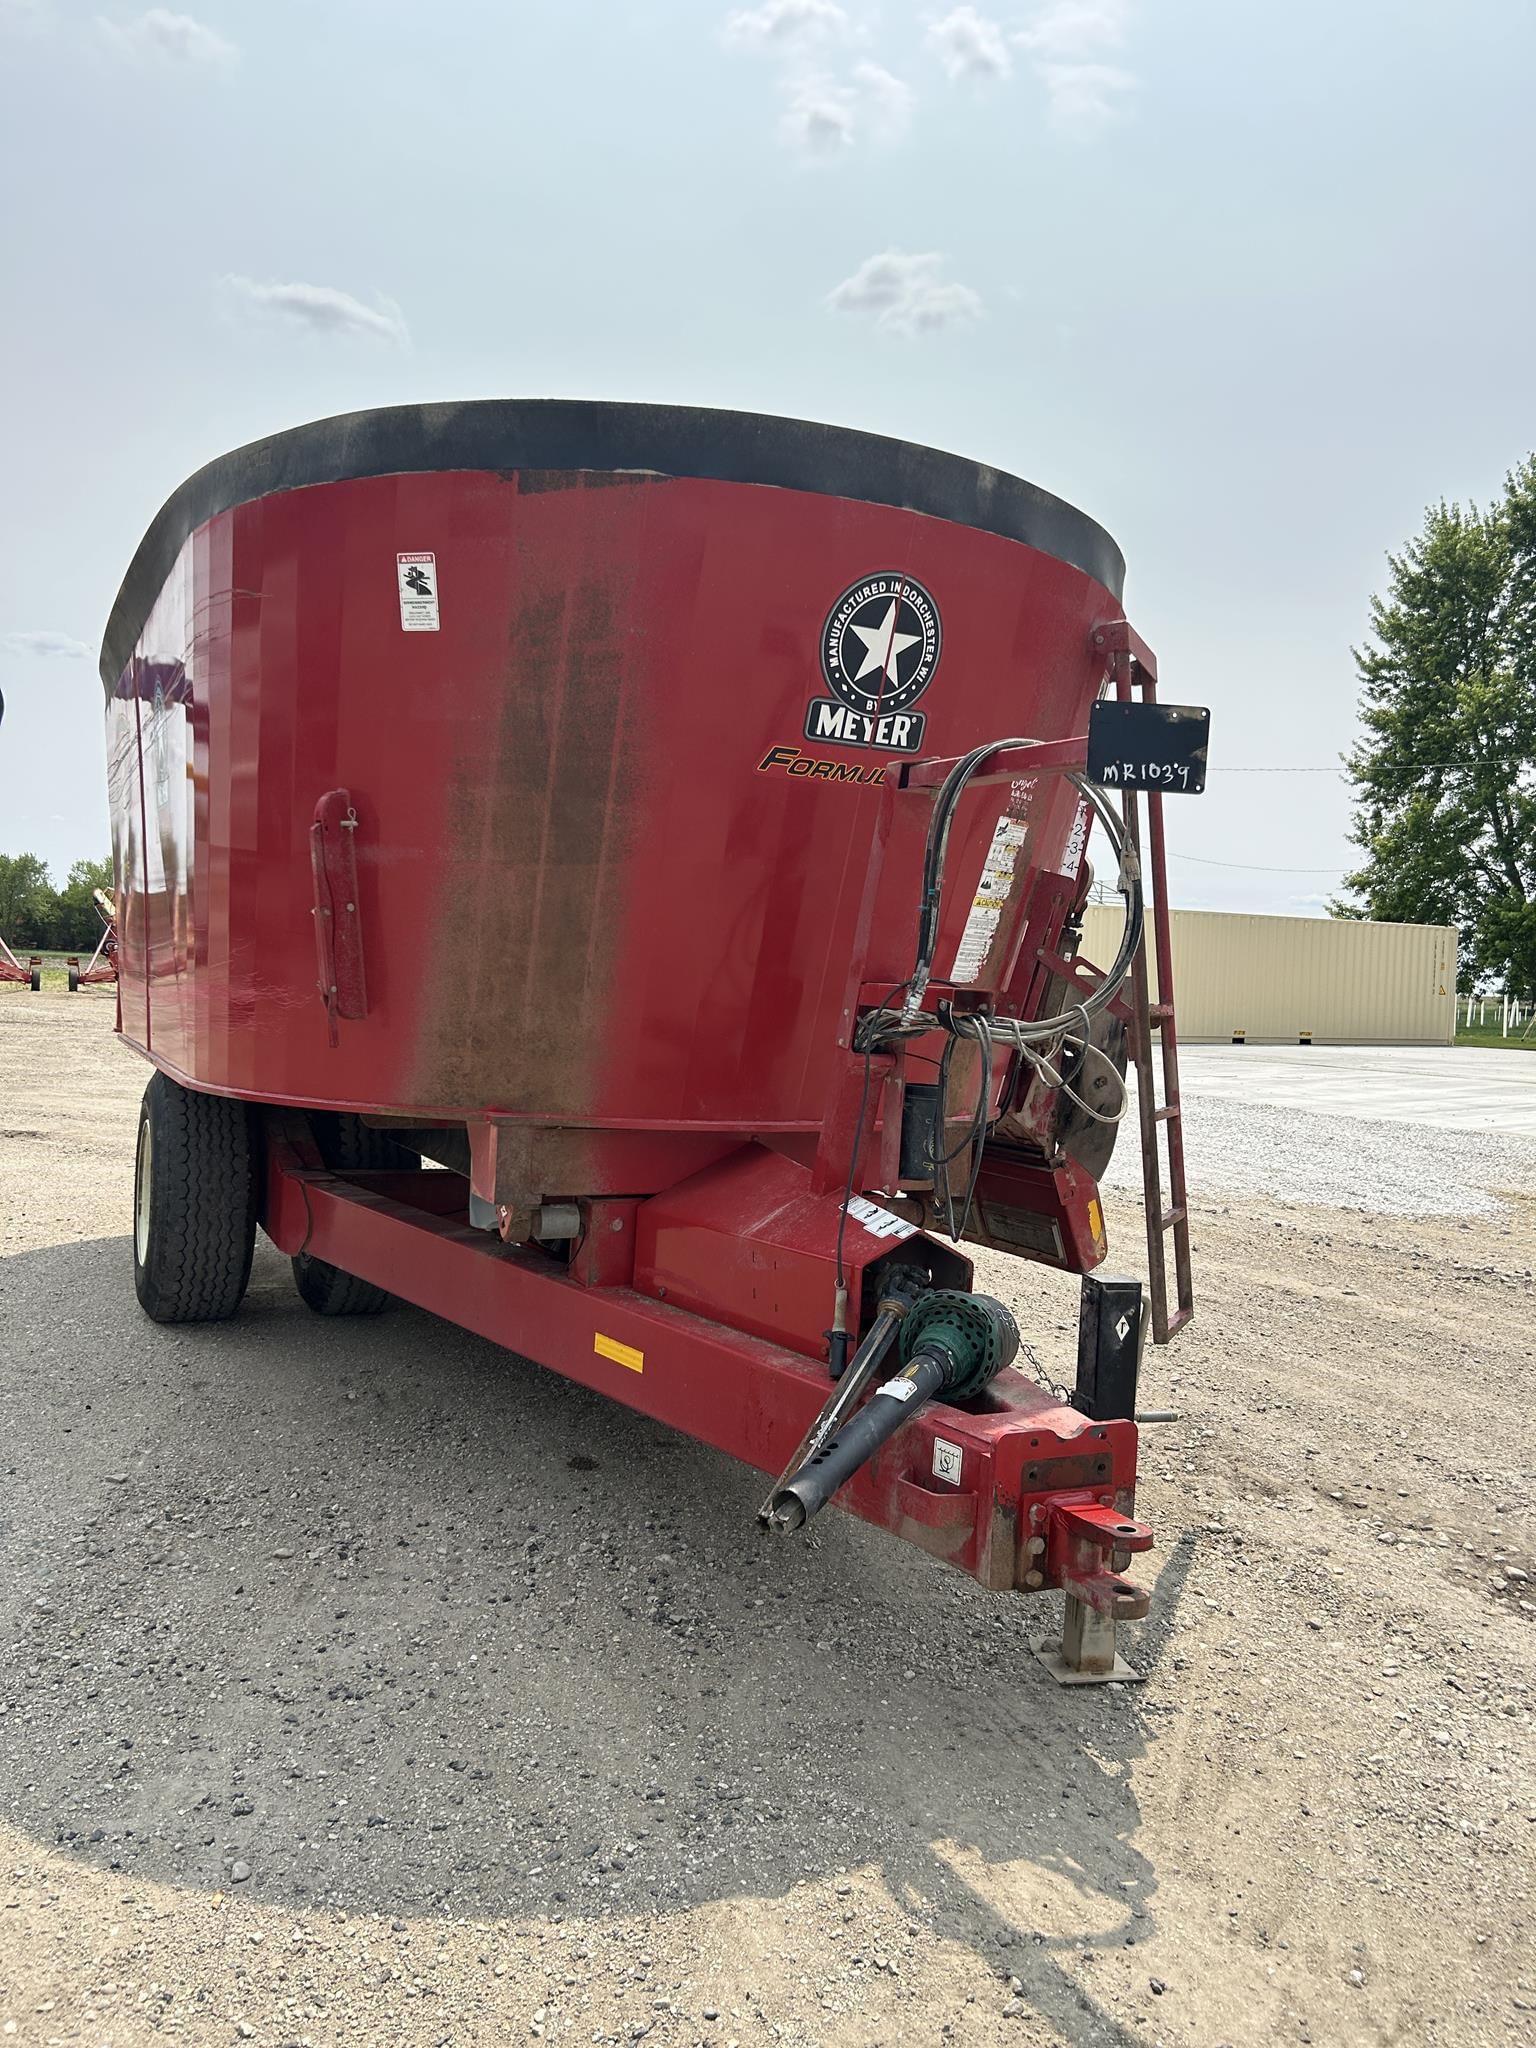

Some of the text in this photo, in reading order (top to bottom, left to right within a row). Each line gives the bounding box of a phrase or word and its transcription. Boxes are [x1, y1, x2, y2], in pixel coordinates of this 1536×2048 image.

[829, 581, 936, 683] MANUFACTURED IN DORCHESTER WI
[757, 745, 887, 786] FORMUL
[1074, 824, 1082, 836] 2
[1070, 842, 1078, 854] 3
[1067, 861, 1074, 872] 4
